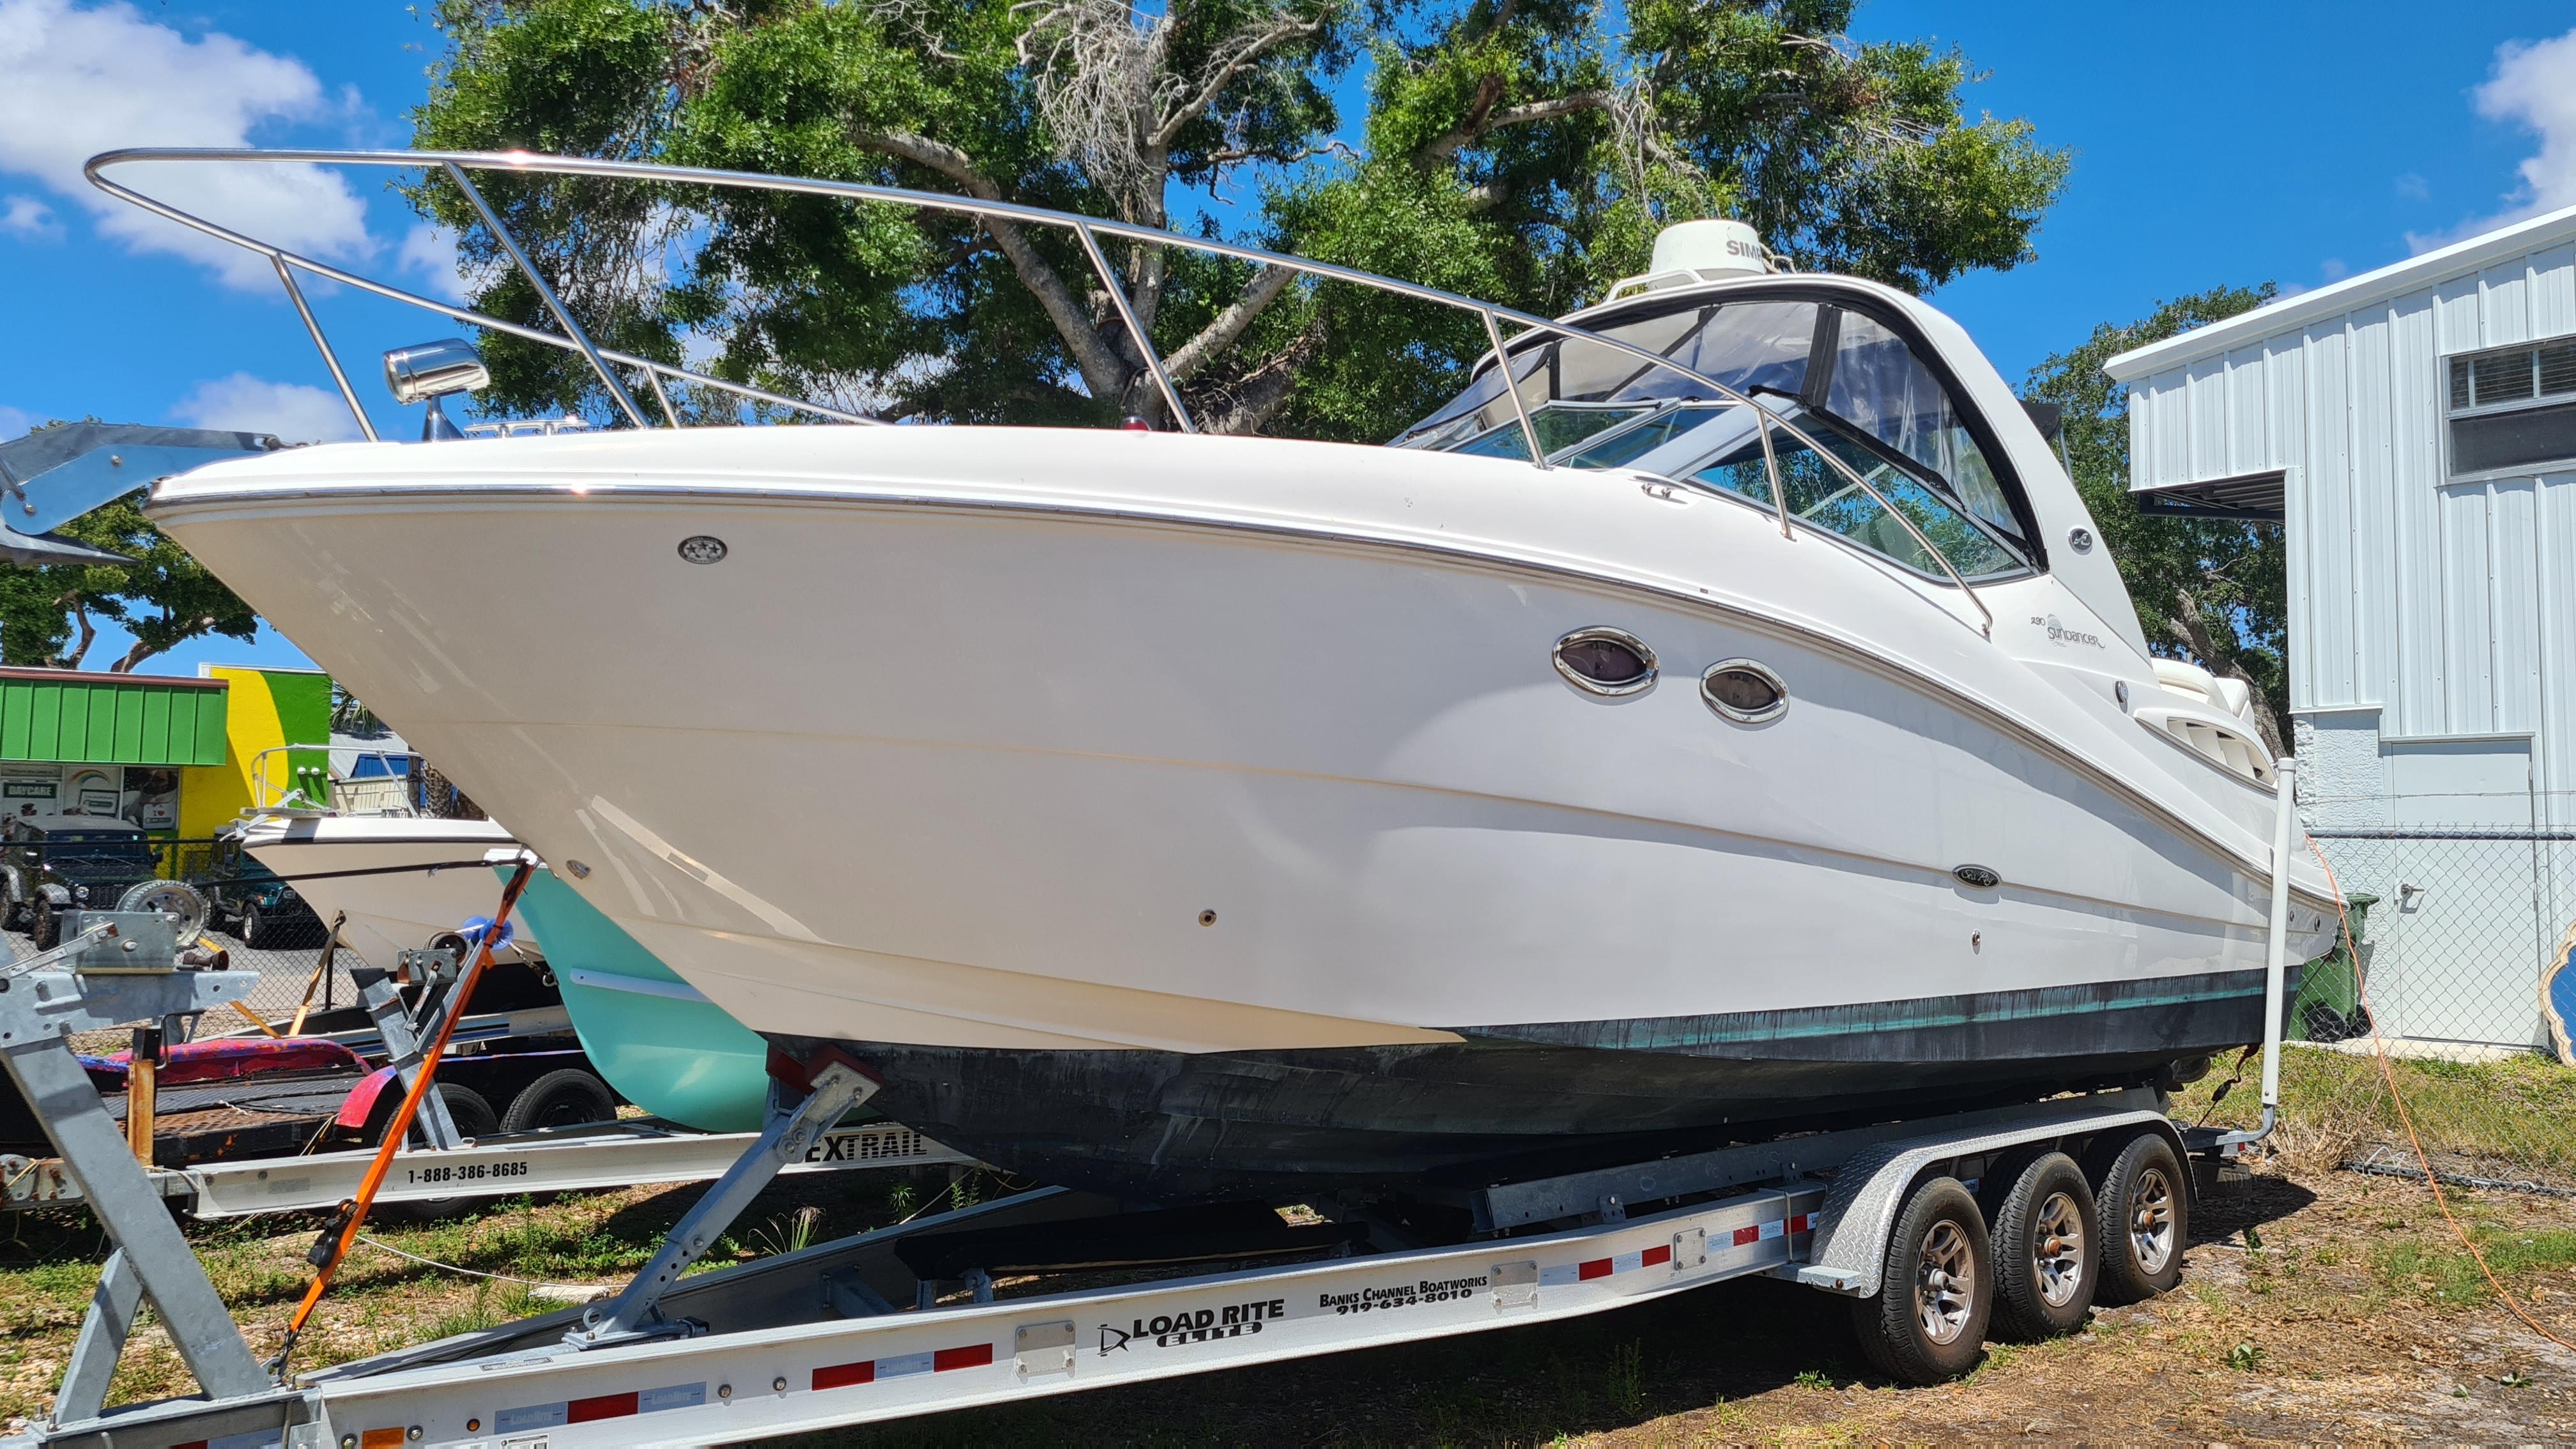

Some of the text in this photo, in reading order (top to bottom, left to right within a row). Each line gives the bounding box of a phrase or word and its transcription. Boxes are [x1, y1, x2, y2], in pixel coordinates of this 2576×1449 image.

[2030, 617, 2046, 626] 290
[8, 785, 52, 797] DAYCARE
[408, 1162, 527, 1183] 1-888-386-8685
[1336, 1289, 1472, 1315] 919-634-8010
[1133, 1299, 1284, 1338] LOAD RITE
[1165, 1323, 1254, 1346] ELITE
